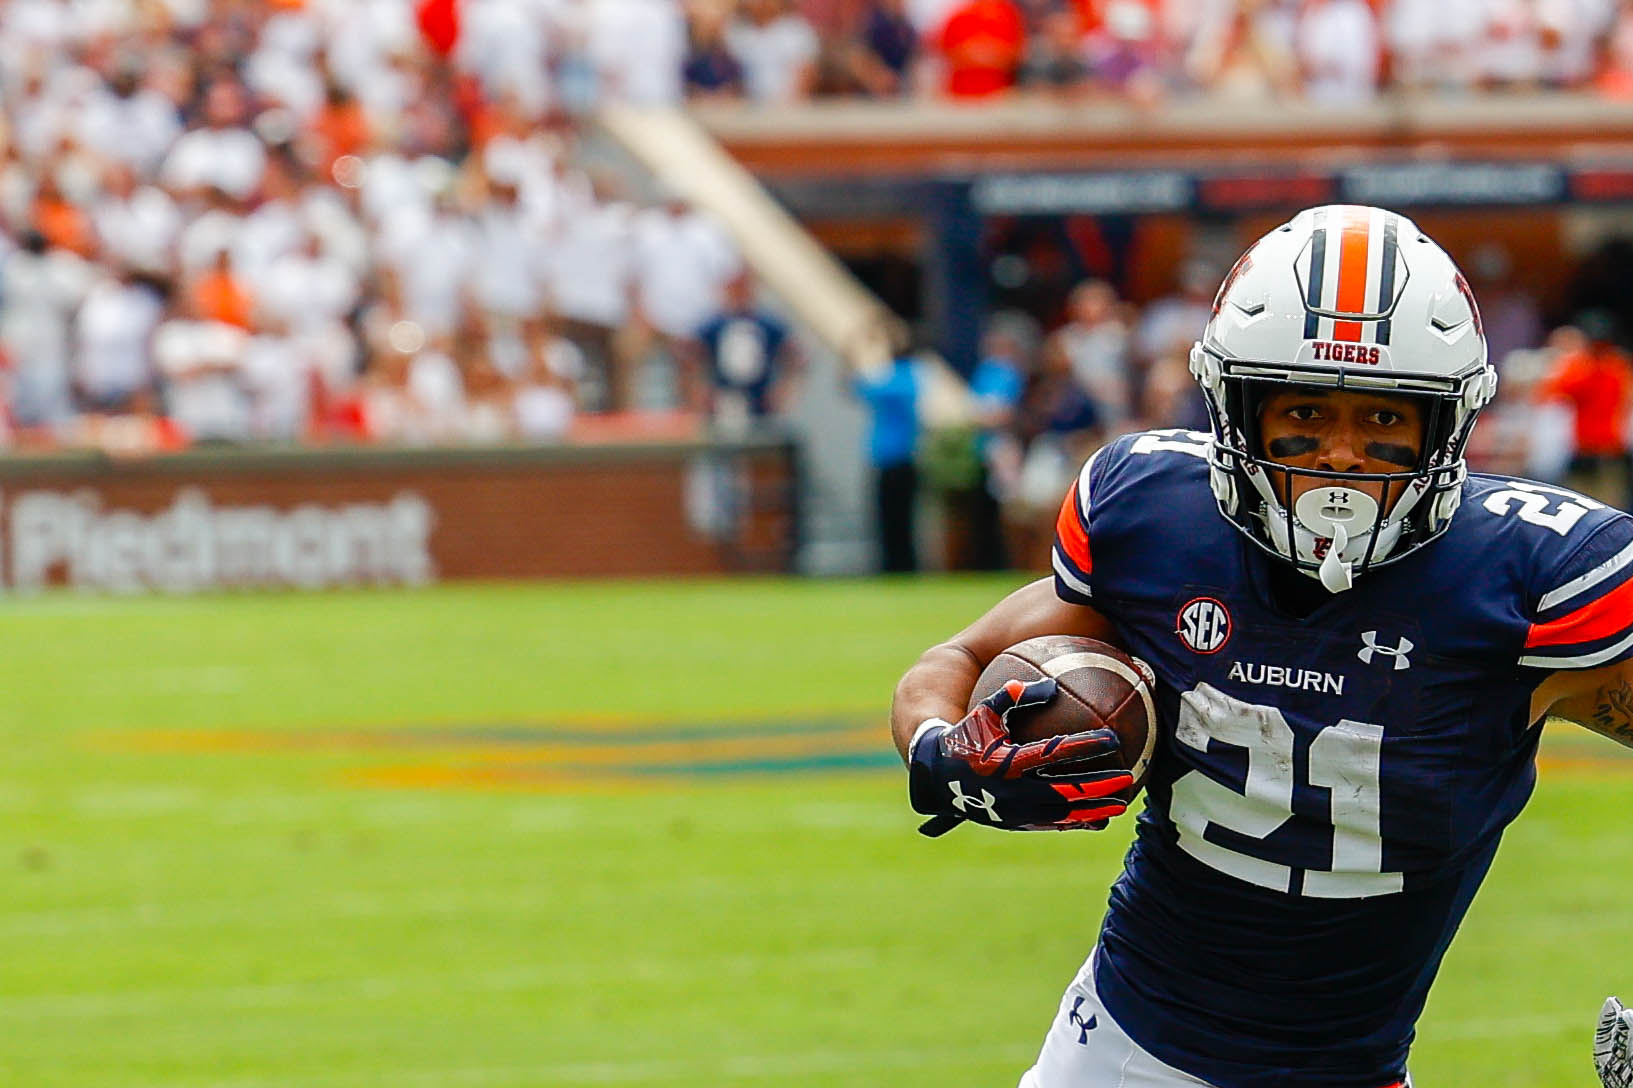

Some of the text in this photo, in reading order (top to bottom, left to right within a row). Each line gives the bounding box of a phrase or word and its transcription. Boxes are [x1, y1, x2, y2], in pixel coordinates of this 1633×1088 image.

[1312, 341, 1381, 366] TIGERS
[10, 487, 438, 593] Piedmont
[1179, 602, 1227, 651] SEC
[1227, 660, 1345, 695] AUBURN
[1168, 681, 1404, 899] 21
